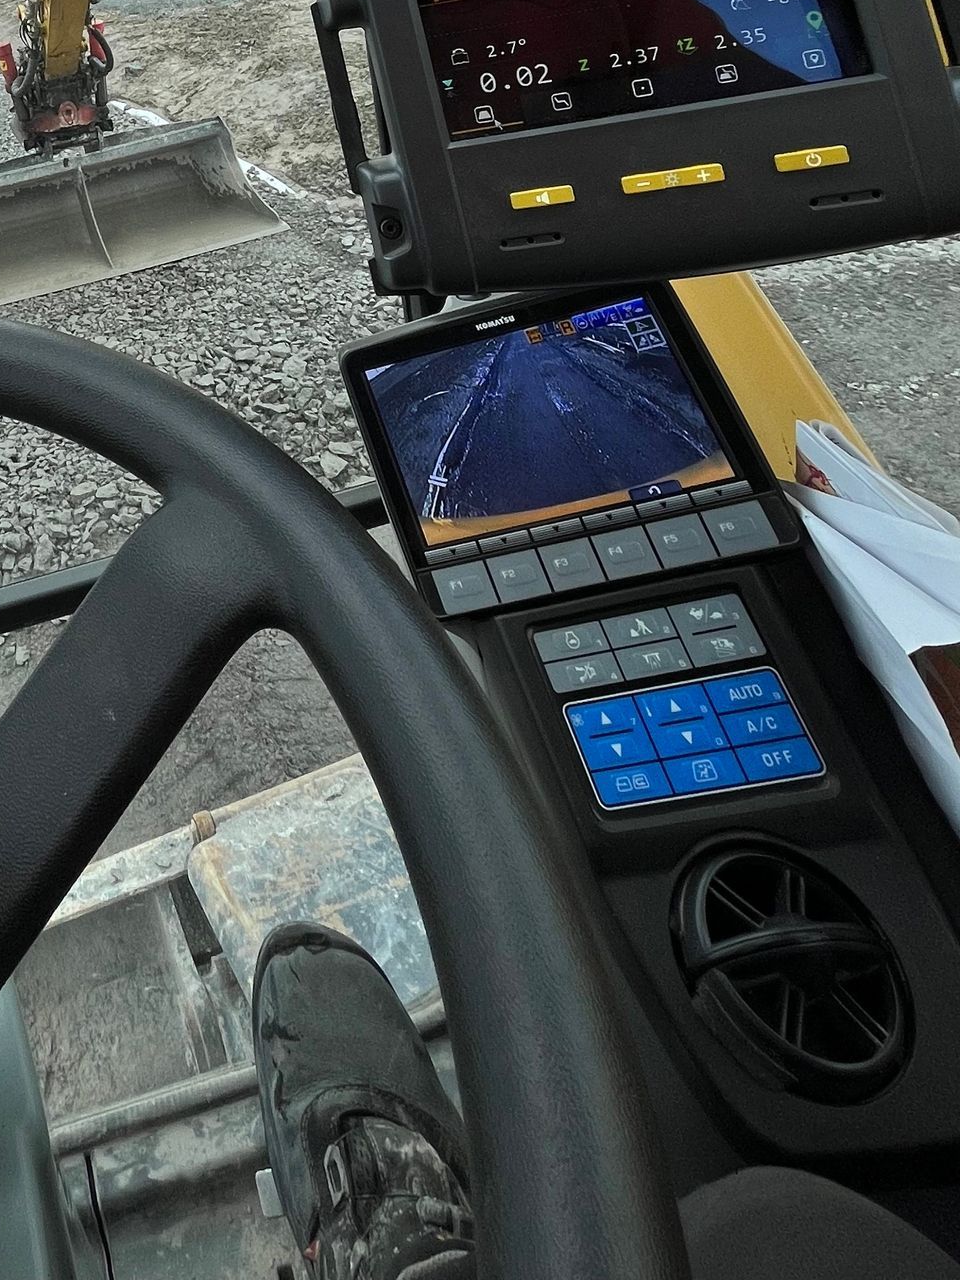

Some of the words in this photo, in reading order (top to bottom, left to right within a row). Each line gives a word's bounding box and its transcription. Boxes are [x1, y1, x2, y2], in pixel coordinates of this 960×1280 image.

[714, 27, 767, 50] 2.35
[486, 39, 526, 58] 2.7°
[609, 46, 659, 68] 2.37
[480, 63, 553, 93] 0.02
[475, 315, 516, 331] KOMATSU
[501, 569, 516, 580] F2
[554, 557, 569, 569] F3
[608, 545, 624, 556] F4
[663, 533, 679, 545] F5
[719, 521, 735, 533] F6
[729, 683, 763, 702] AUTO
[747, 717, 777, 734] A/C
[762, 750, 792, 767] OFF
